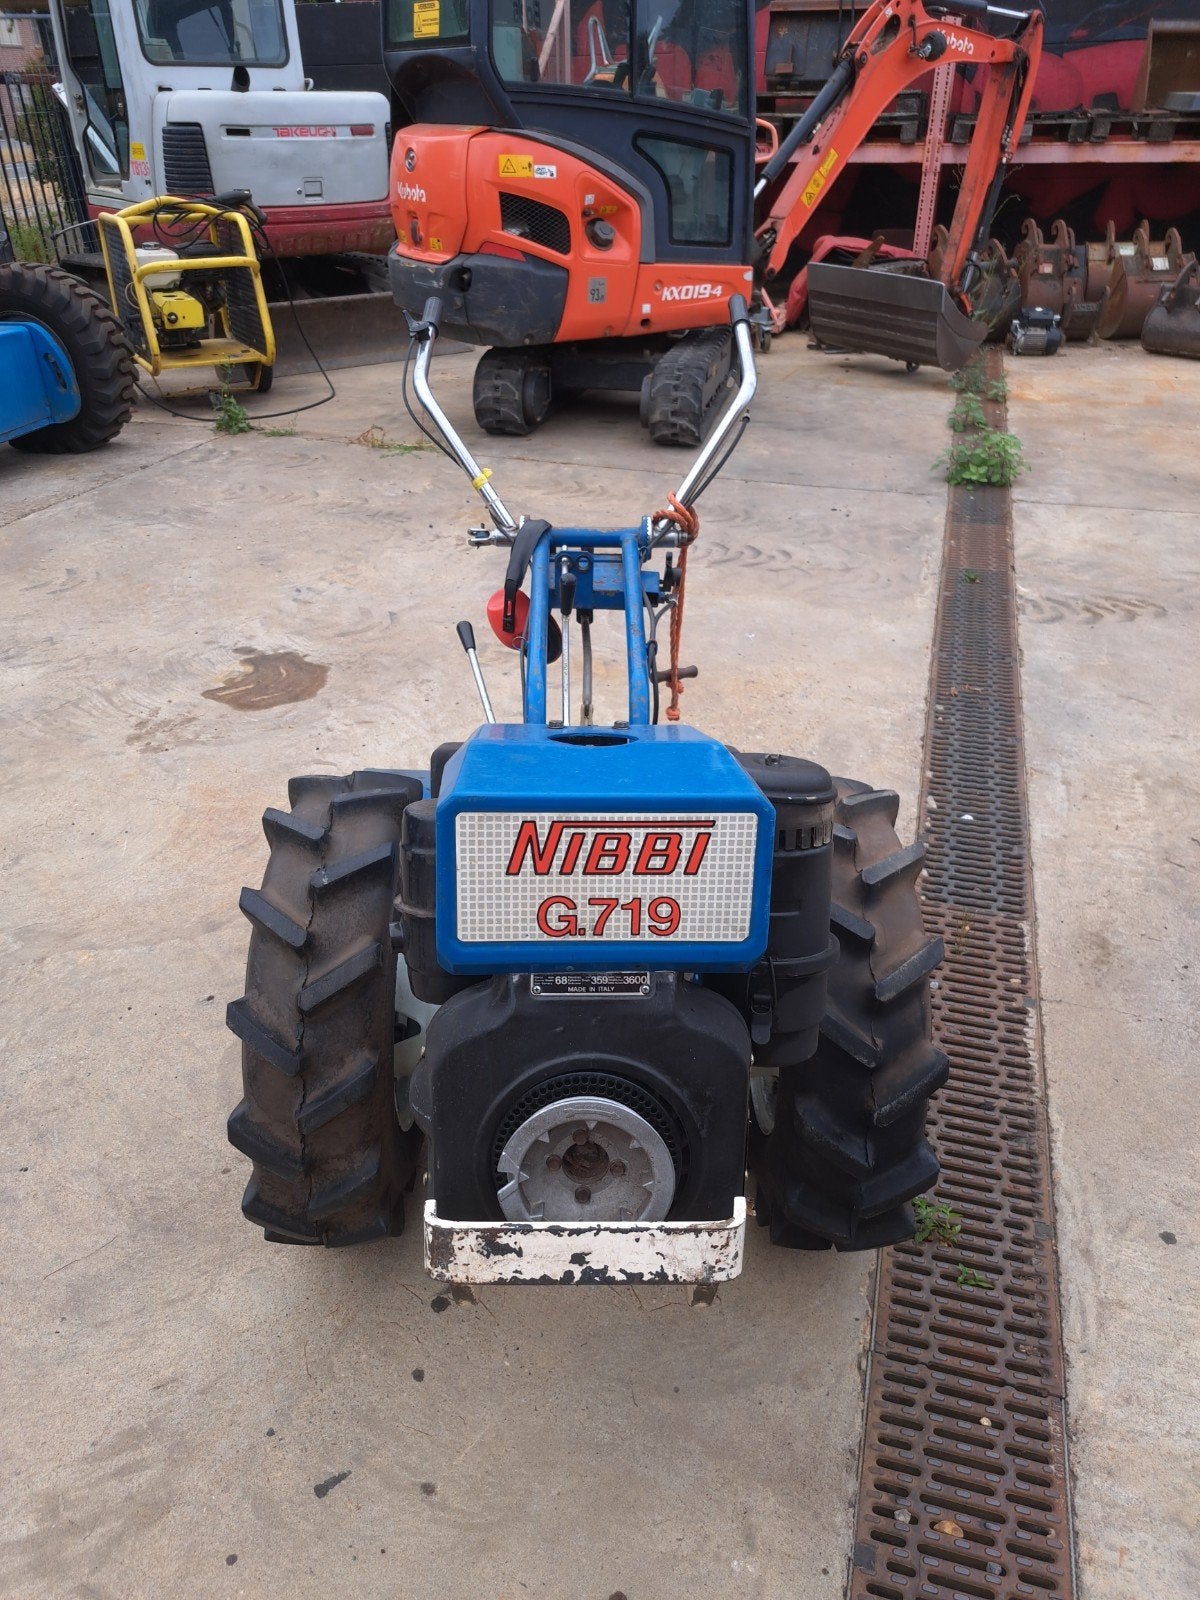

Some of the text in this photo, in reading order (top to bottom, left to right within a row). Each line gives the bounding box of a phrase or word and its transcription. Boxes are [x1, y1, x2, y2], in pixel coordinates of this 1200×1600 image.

[397, 182, 426, 203] Kubota
[661, 284, 723, 301] KX019-4
[505, 820, 716, 876] NIBBI
[536, 895, 682, 937] G.719
[555, 976, 568, 985] 68
[591, 975, 608, 985] 359
[623, 975, 647, 985] 3600
